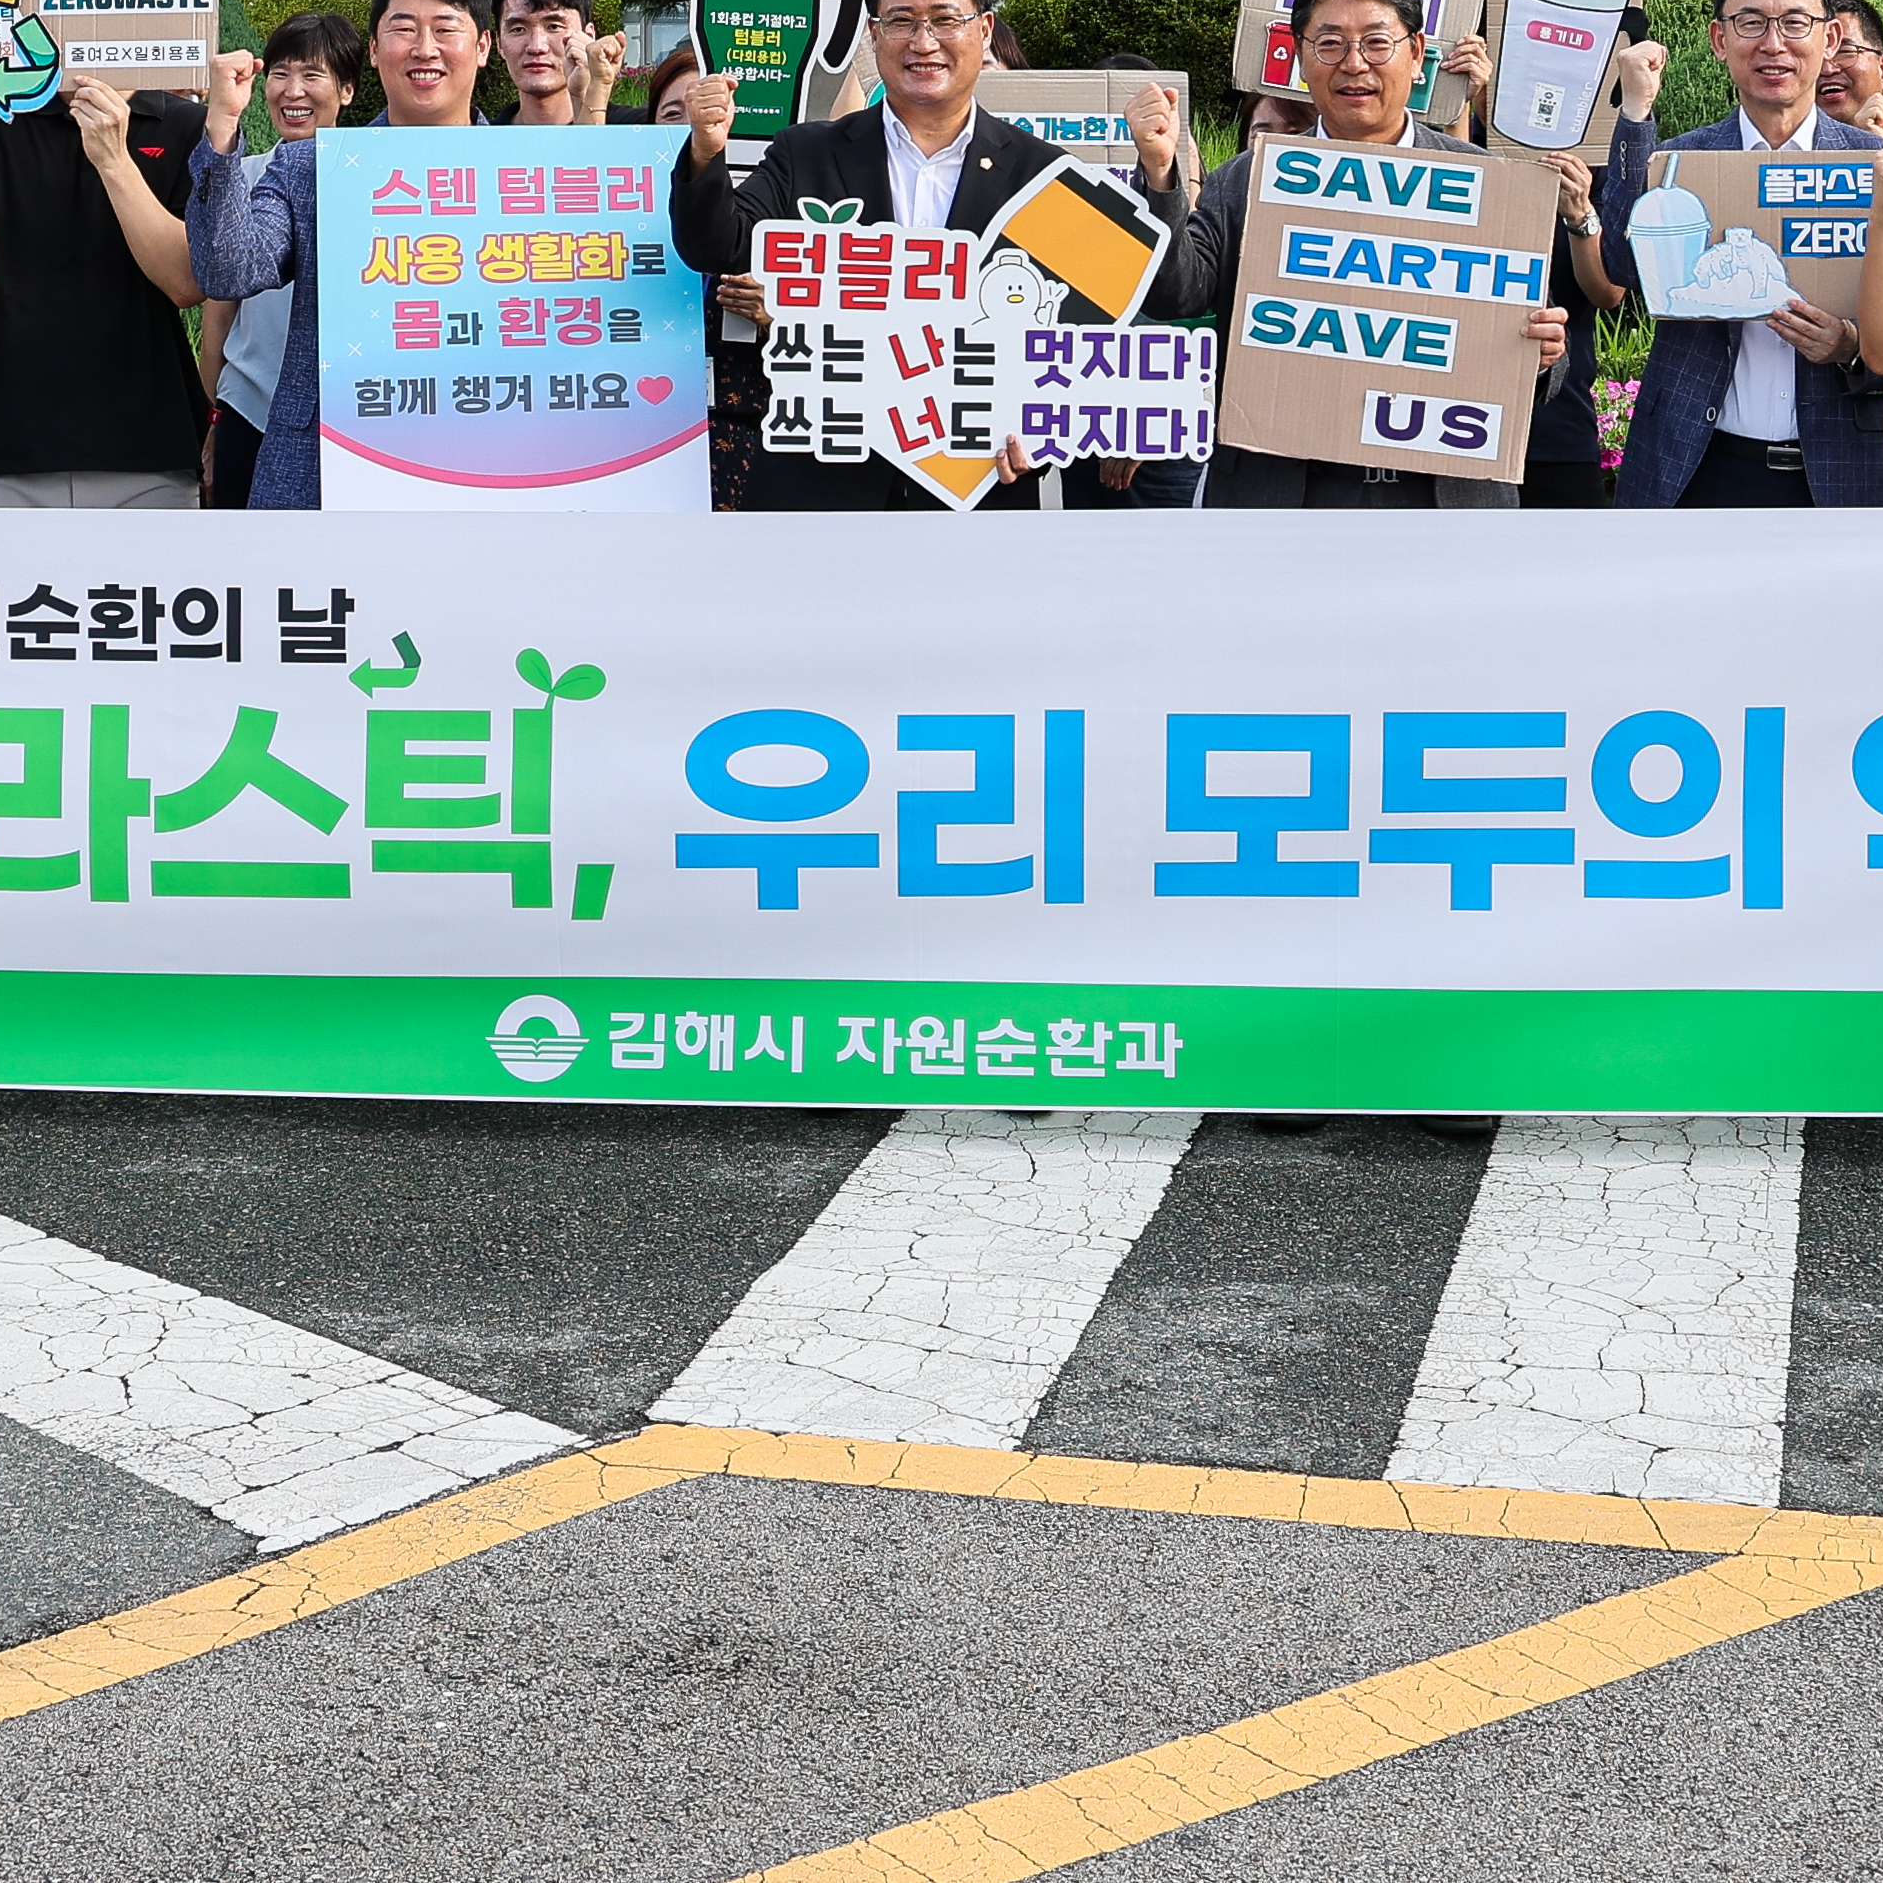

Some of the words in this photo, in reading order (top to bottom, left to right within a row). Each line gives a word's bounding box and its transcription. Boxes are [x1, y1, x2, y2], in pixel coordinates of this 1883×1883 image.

[710, 11, 754, 27] 1회용컵
[757, 13, 808, 29] 거절하고
[734, 28, 782, 47] 텀블러
[726, 48, 787, 66] (다회용컵)
[1571, 81, 1594, 134] tumbler
[371, 167, 478, 215] 스텐
[497, 166, 655, 214] 텀블러
[1272, 150, 1476, 214] SAVE
[361, 233, 463, 285] 사용
[477, 230, 667, 283] 생활화로
[763, 231, 968, 311] 텀블러
[1286, 231, 1544, 302] EARTH
[392, 300, 483, 350] 몸과
[498, 296, 643, 347] 환경을
[1248, 300, 1452, 367] SAVE
[768, 322, 865, 382] 쓰는
[887, 323, 996, 387] 나는
[1025, 329, 1213, 389] 멋지다!
[354, 376, 437, 418] 함께
[452, 374, 533, 414] 챙겨
[548, 372, 630, 411] 봐요
[1374, 395, 1490, 450] US
[768, 396, 865, 456] 쓰는
[887, 395, 993, 454] 너도
[1021, 402, 1209, 462] 멋지다!
[277, 586, 356, 665] 날
[674, 707, 1087, 912] 우리
[1153, 706, 1786, 912] 모두의
[606, 1009, 806, 1076] 김해시
[835, 1014, 1184, 1080] 자원순환과
